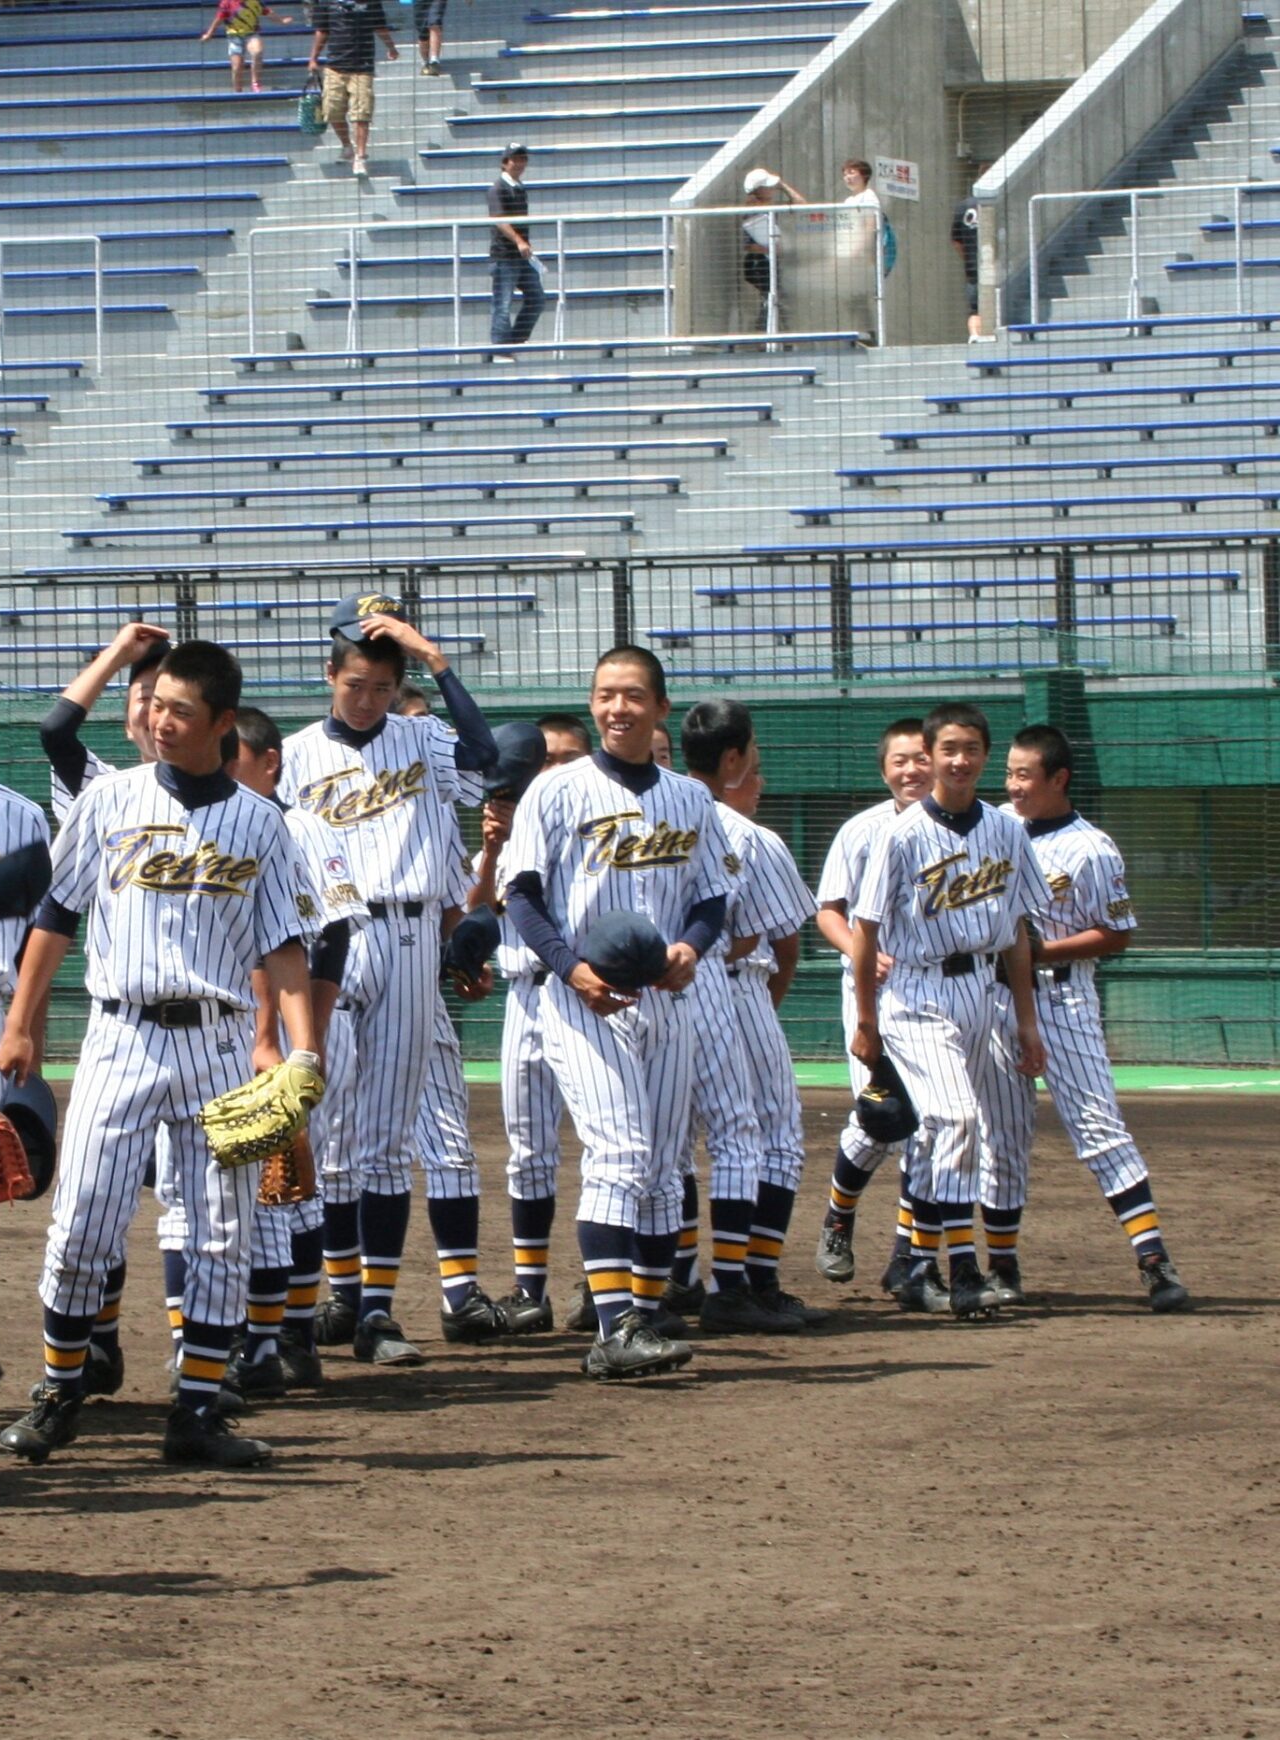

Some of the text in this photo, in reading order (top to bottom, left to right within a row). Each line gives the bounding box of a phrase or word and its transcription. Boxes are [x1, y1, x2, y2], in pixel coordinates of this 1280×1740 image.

[298, 760, 429, 829] Teine
[105, 824, 259, 897] Teine
[578, 811, 698, 876] Teine
